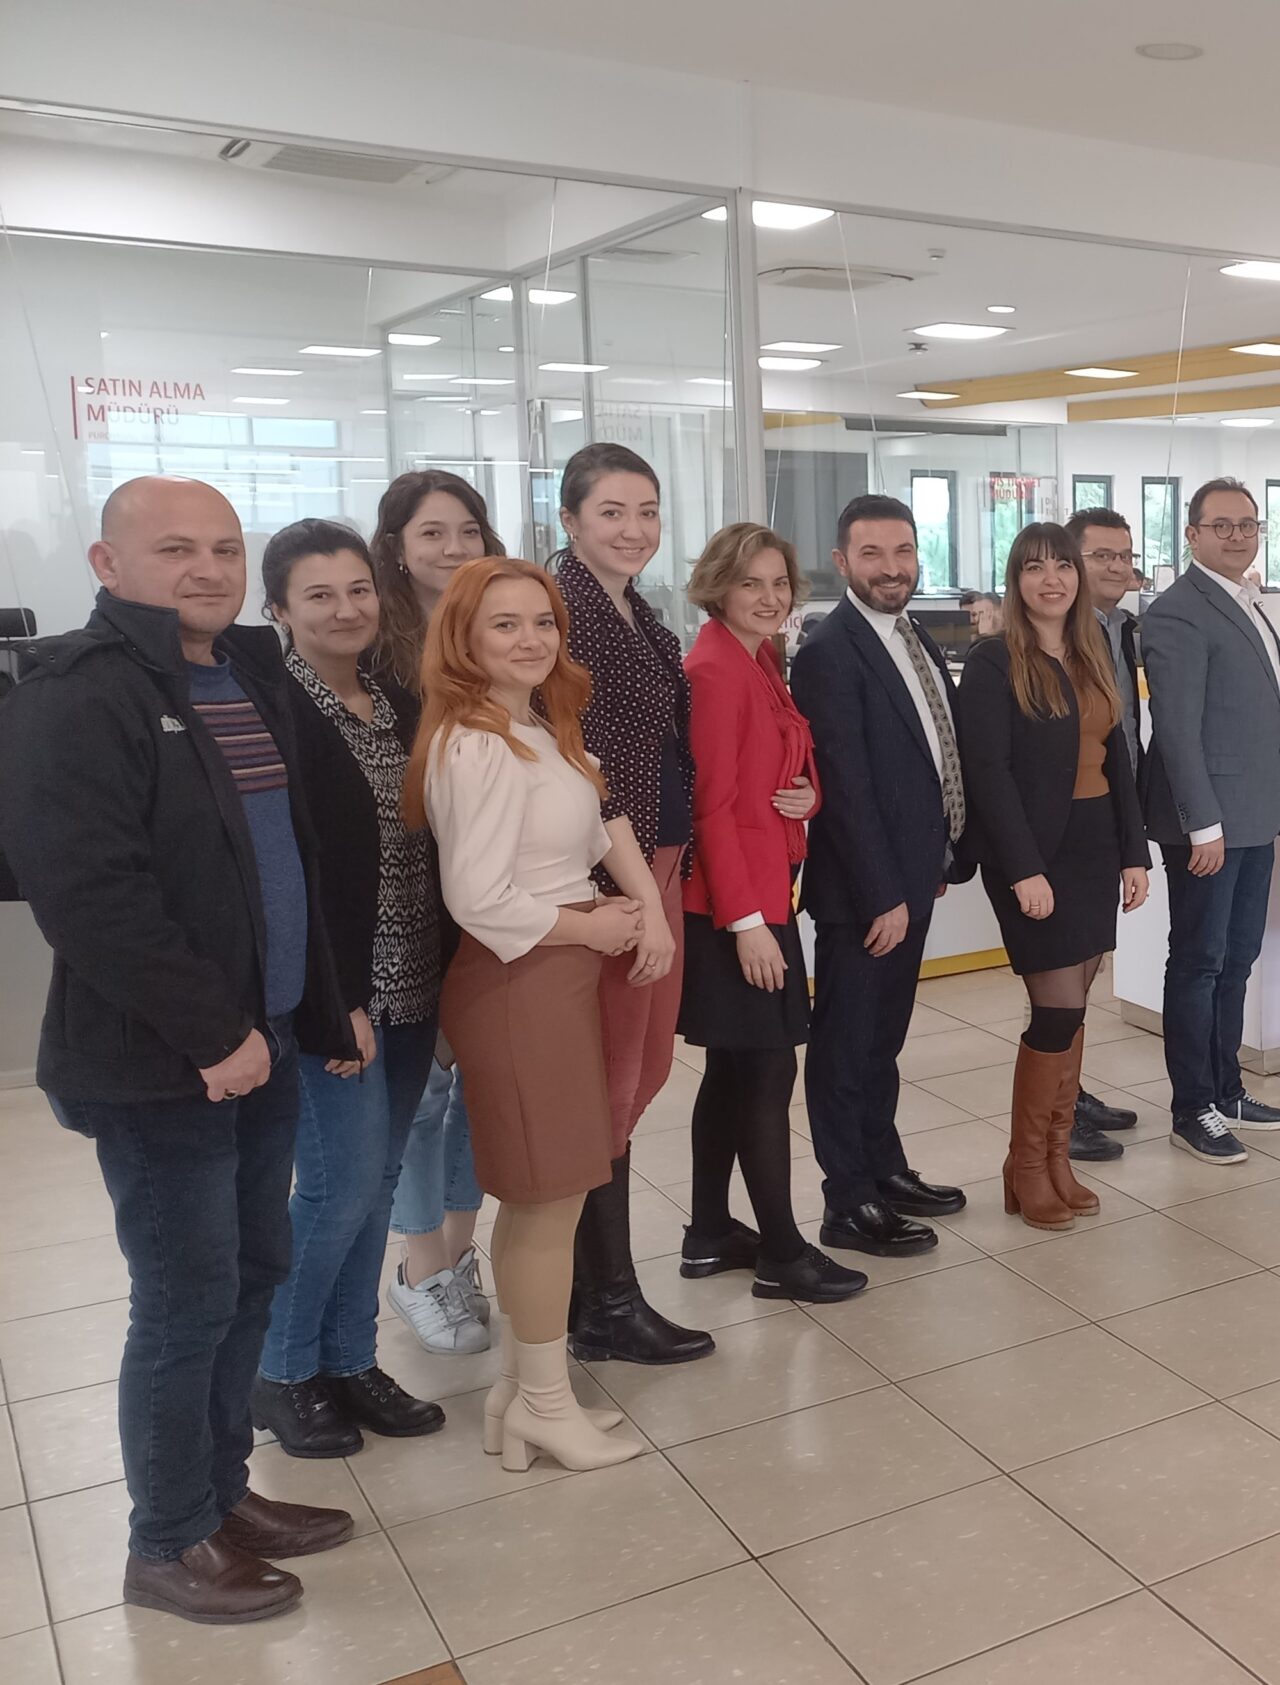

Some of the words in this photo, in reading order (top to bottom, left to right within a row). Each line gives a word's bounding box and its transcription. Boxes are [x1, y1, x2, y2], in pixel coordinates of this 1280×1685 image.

[85, 377, 142, 397] SATIN
[149, 381, 205, 400] ALMA
[87, 402, 179, 425] MÜDÜRÜ
